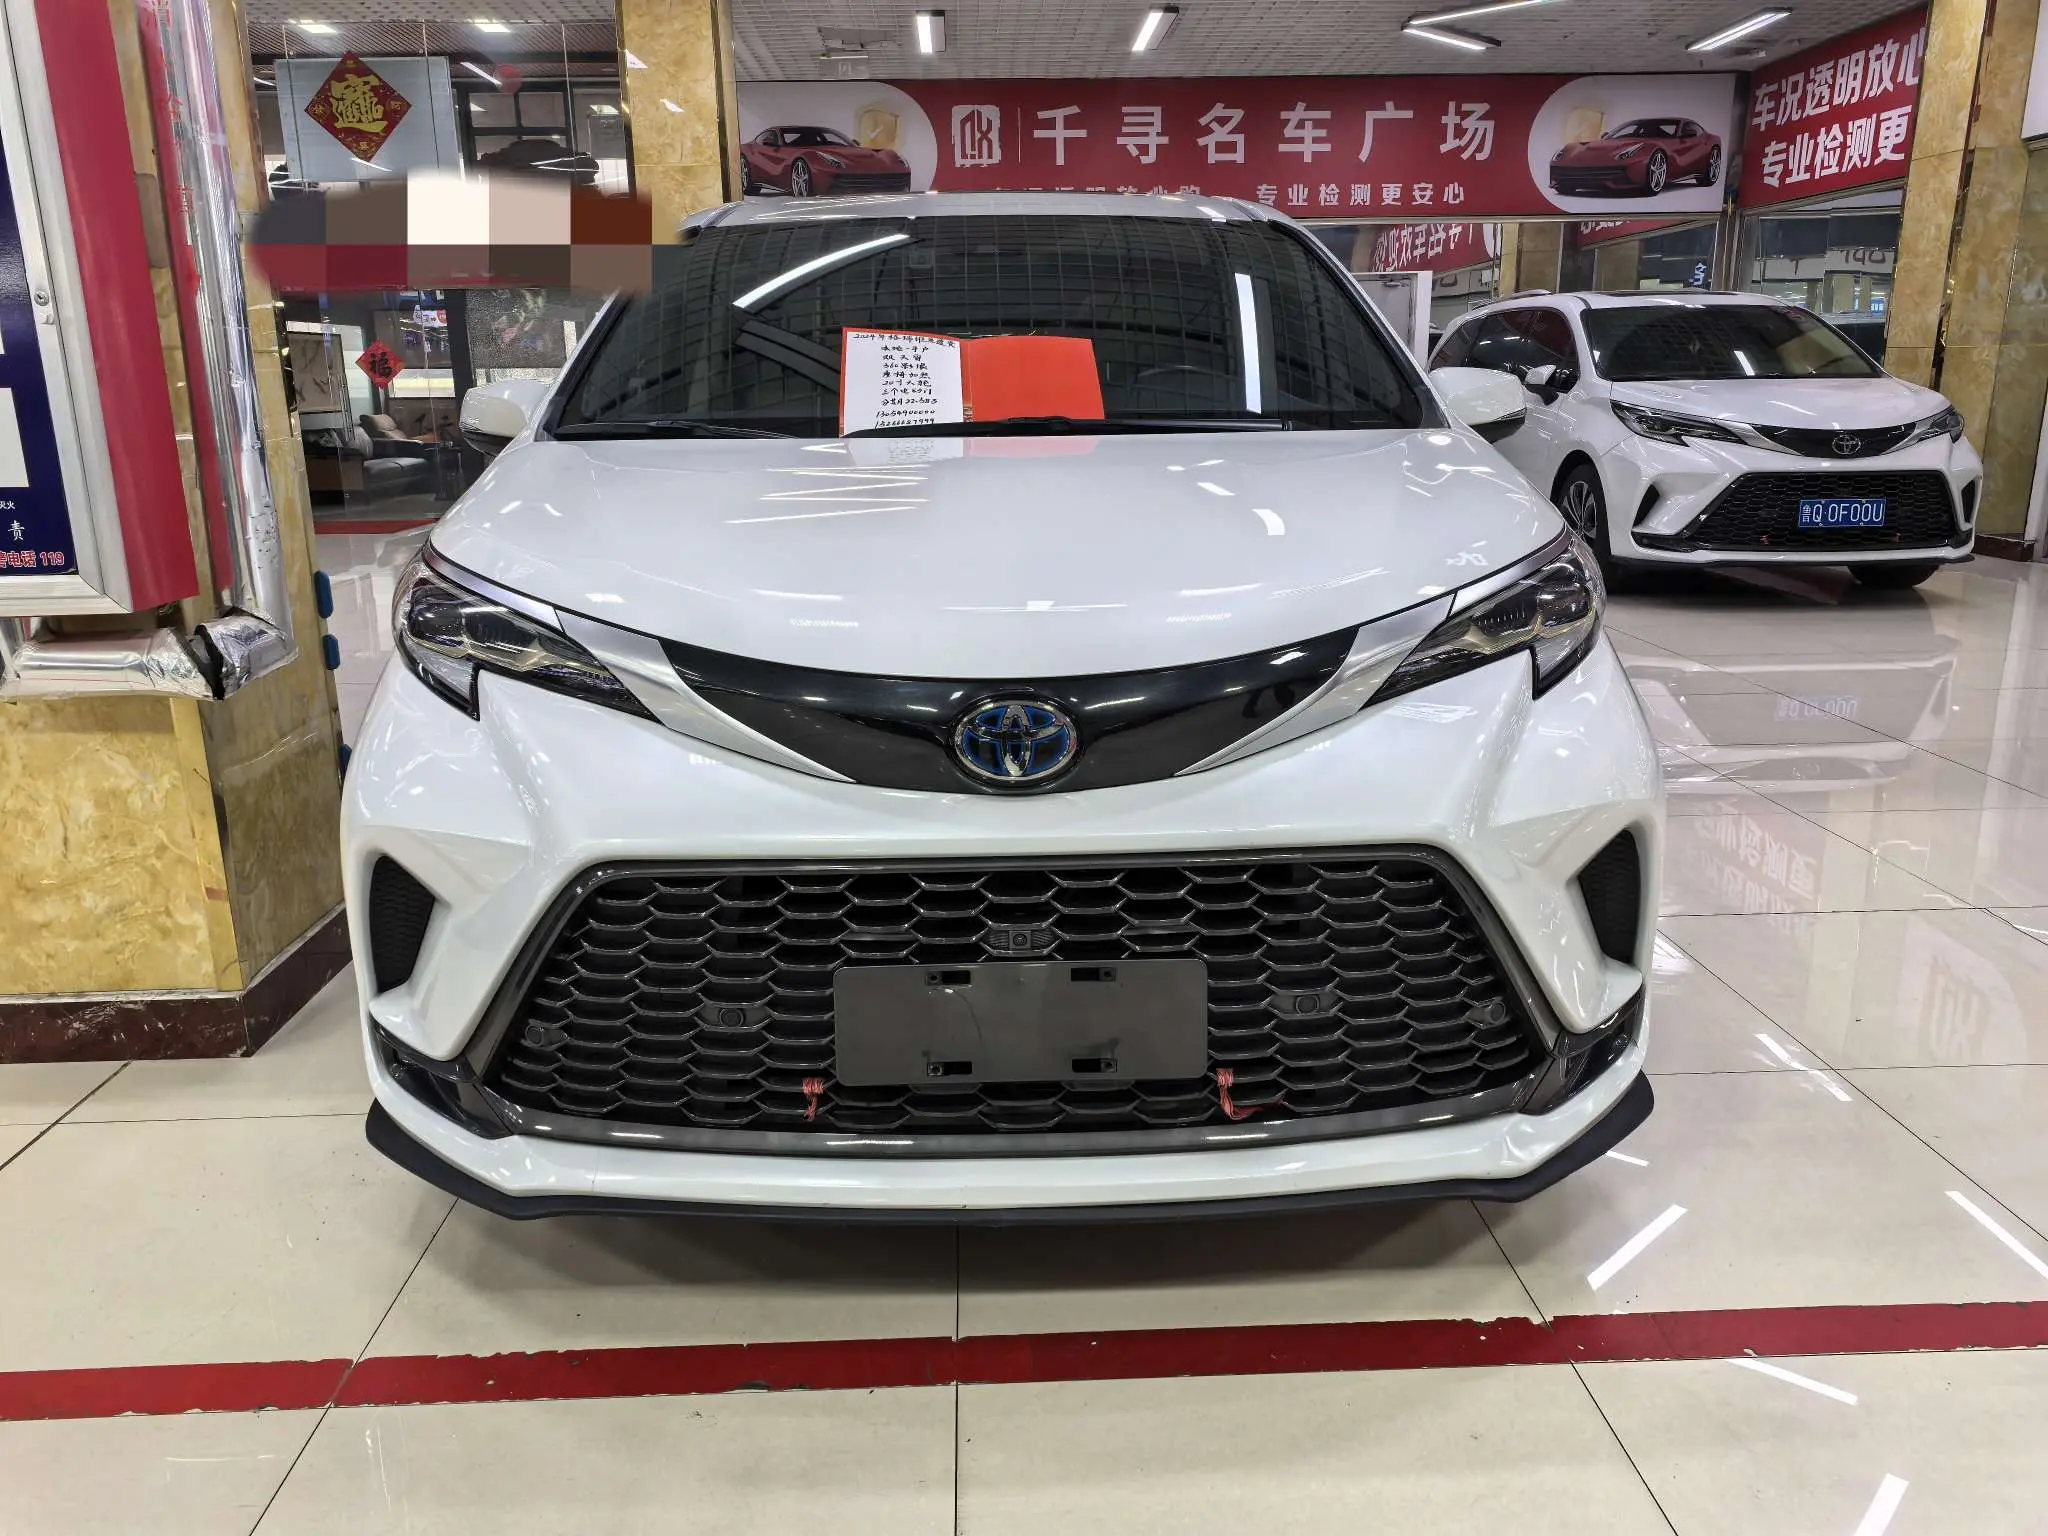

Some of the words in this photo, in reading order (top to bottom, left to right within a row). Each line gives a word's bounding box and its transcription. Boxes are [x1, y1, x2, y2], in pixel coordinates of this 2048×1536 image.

[1033, 102, 1497, 165] 千寻名车广场
[1762, 105, 1912, 188] 专业检测更
[1256, 182, 1464, 207] 专业检测更安心
[369, 351, 393, 378] 福
[8, 520, 25, 541] 责
[40, 551, 65, 566] 119
